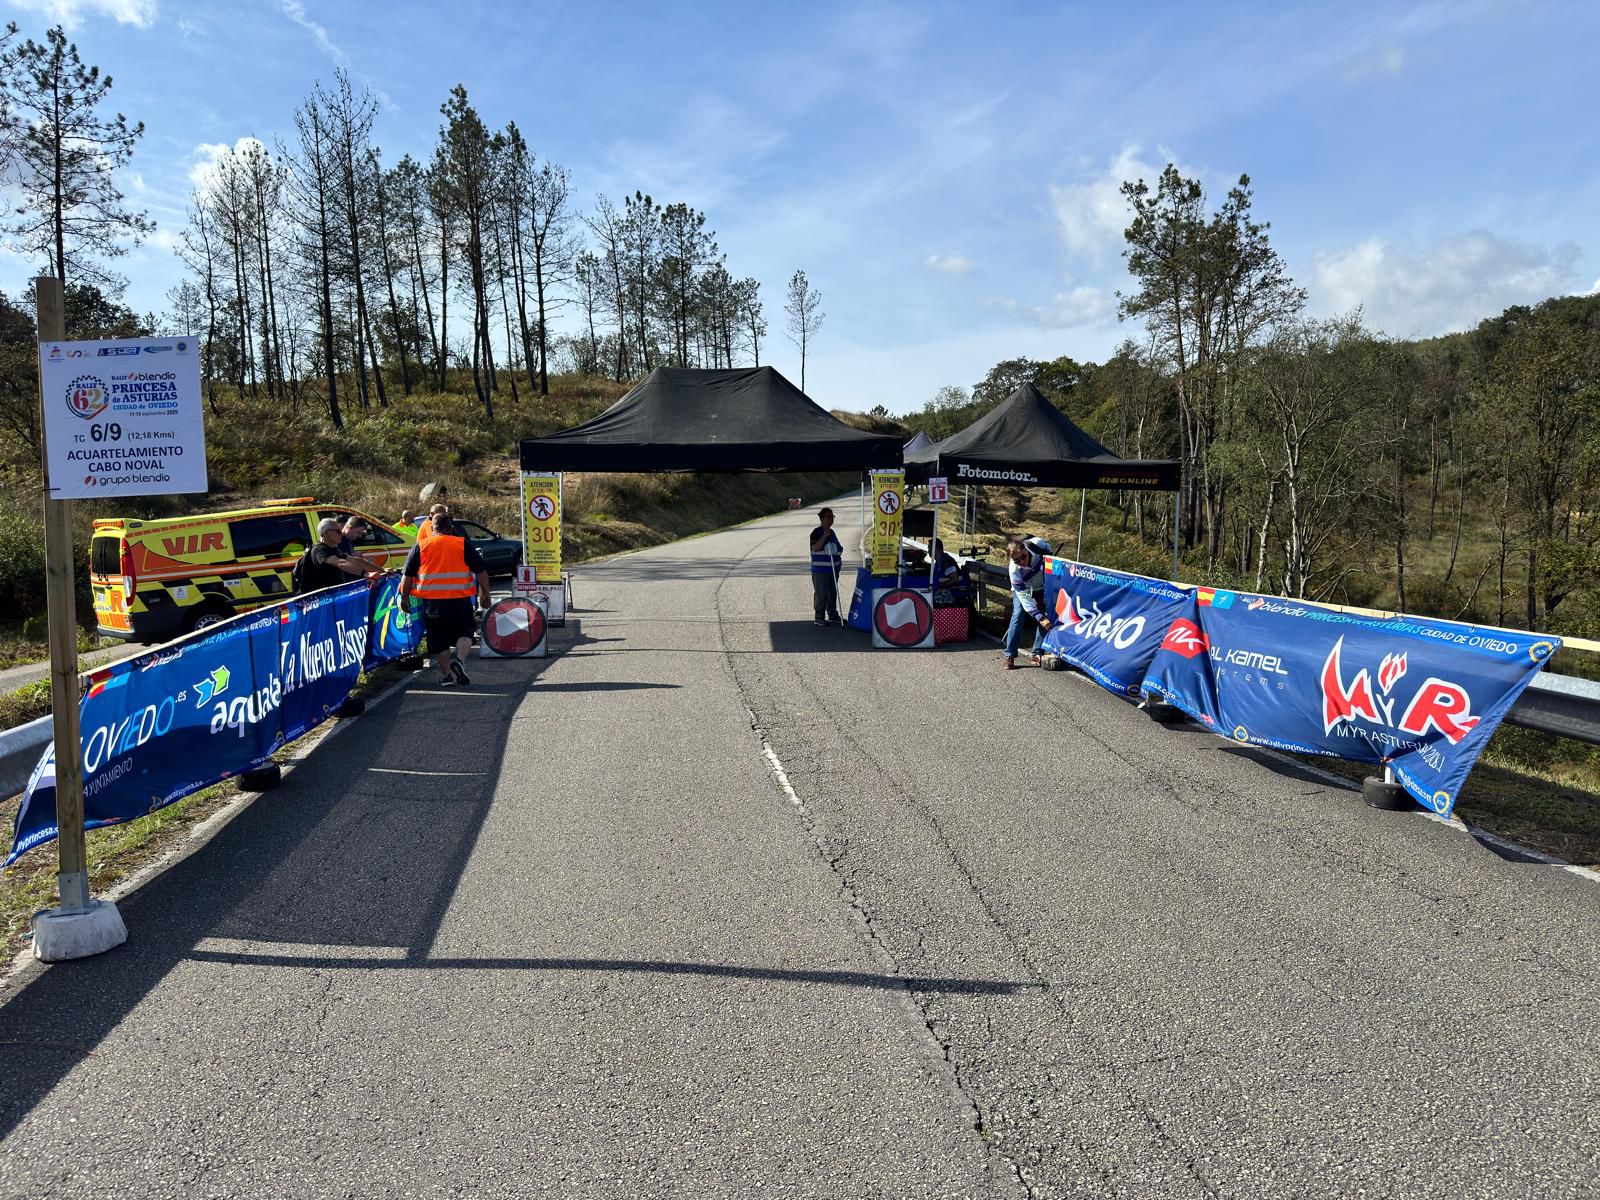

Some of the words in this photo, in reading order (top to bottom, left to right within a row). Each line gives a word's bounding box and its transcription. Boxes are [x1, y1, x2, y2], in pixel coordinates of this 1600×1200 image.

[138, 372, 176, 381] blendio
[112, 382, 176, 393] PRINCESA
[74, 389, 103, 410] 62
[122, 392, 178, 403] ASTURIAS
[74, 434, 85, 442] TC
[90, 423, 122, 442] 6/9
[154, 431, 175, 439] Kms)
[67, 446, 183, 460] ACUARTELAMIENTO
[88, 462, 121, 472] CABO
[125, 460, 164, 471] NOVAL
[100, 475, 130, 486] grupo
[132, 473, 170, 482] blendio
[1259, 602, 1306, 618] blendio
[1420, 628, 1454, 643] CIUDAD
[1454, 635, 1467, 644] DE
[1469, 637, 1518, 654] OVIEDO
[280, 641, 294, 696] La
[300, 630, 336, 688] Nueva
[1338, 725, 1367, 738] MYR
